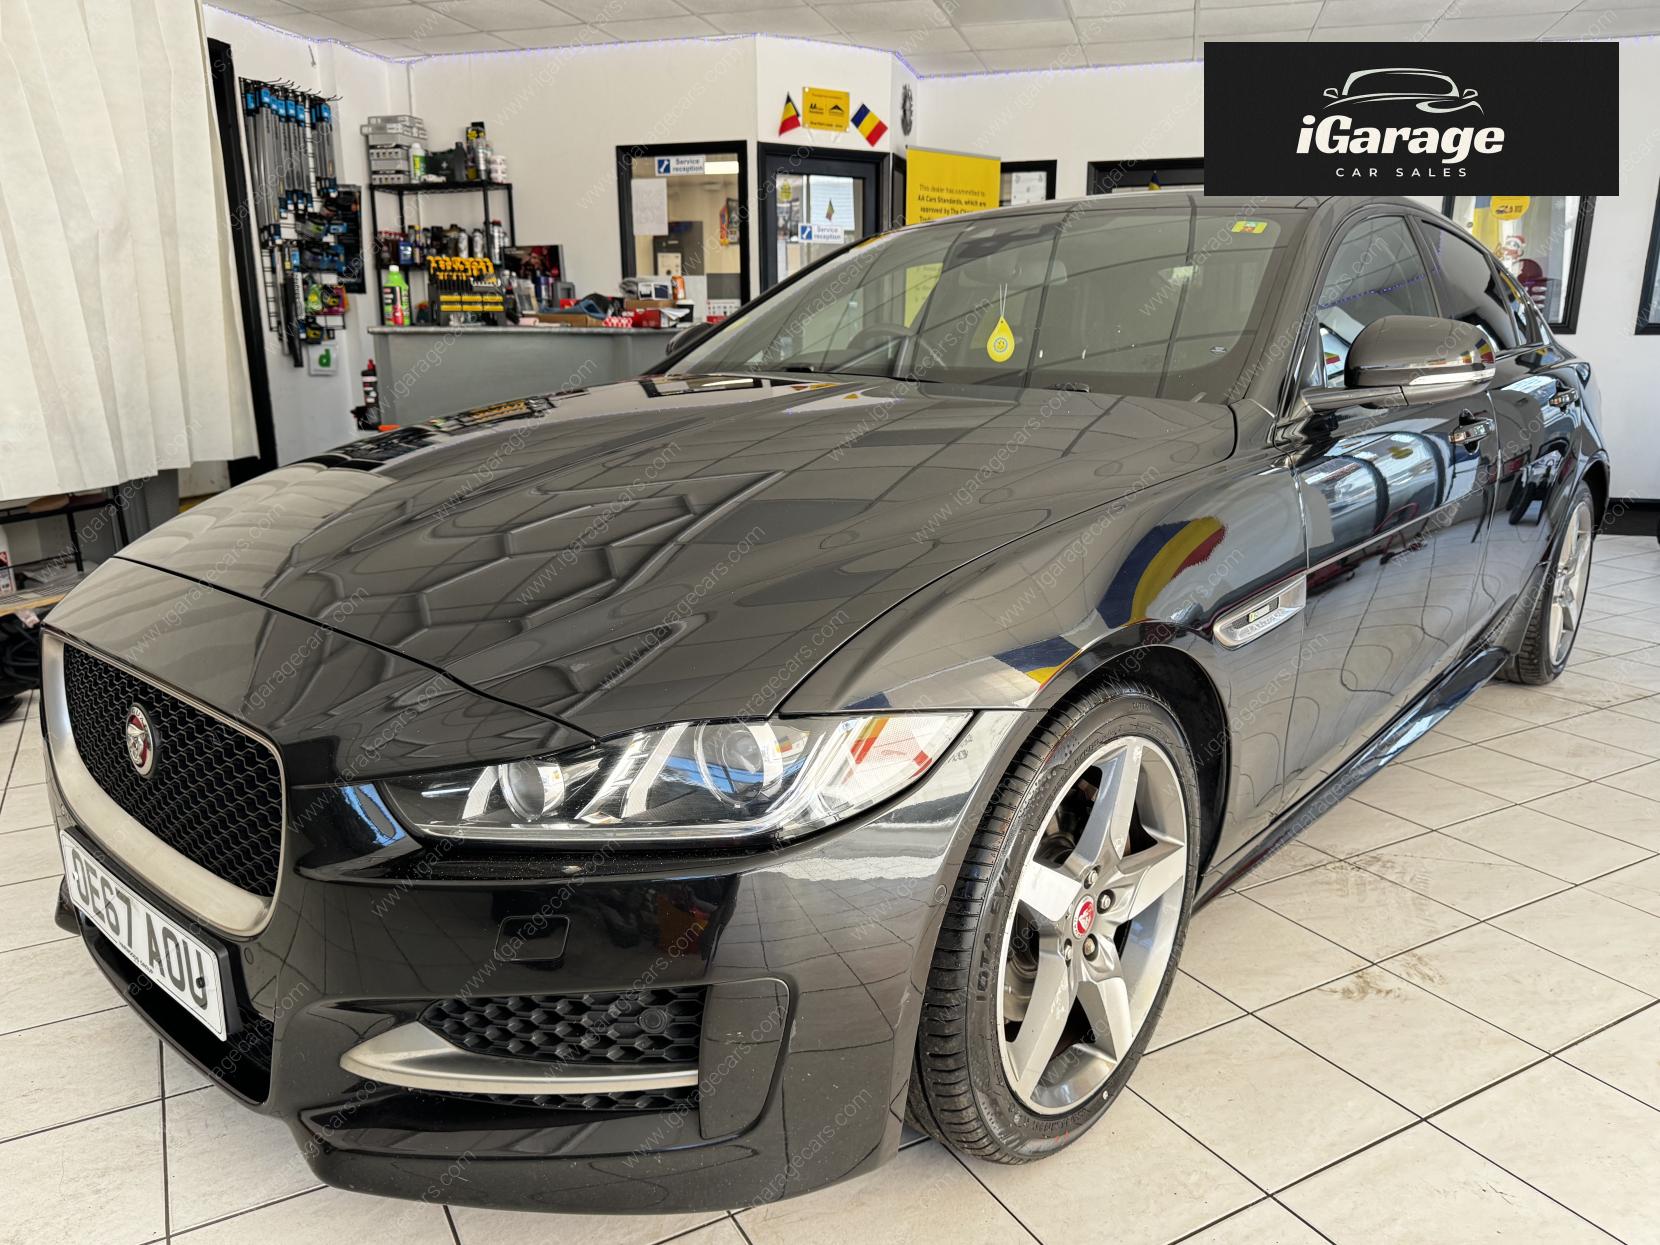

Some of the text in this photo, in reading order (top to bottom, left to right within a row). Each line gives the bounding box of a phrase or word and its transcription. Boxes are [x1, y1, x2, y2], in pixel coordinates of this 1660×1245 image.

[71, 849, 134, 950] OE67
[145, 912, 208, 1010] AOU
[975, 932, 992, 1002] IOTA
